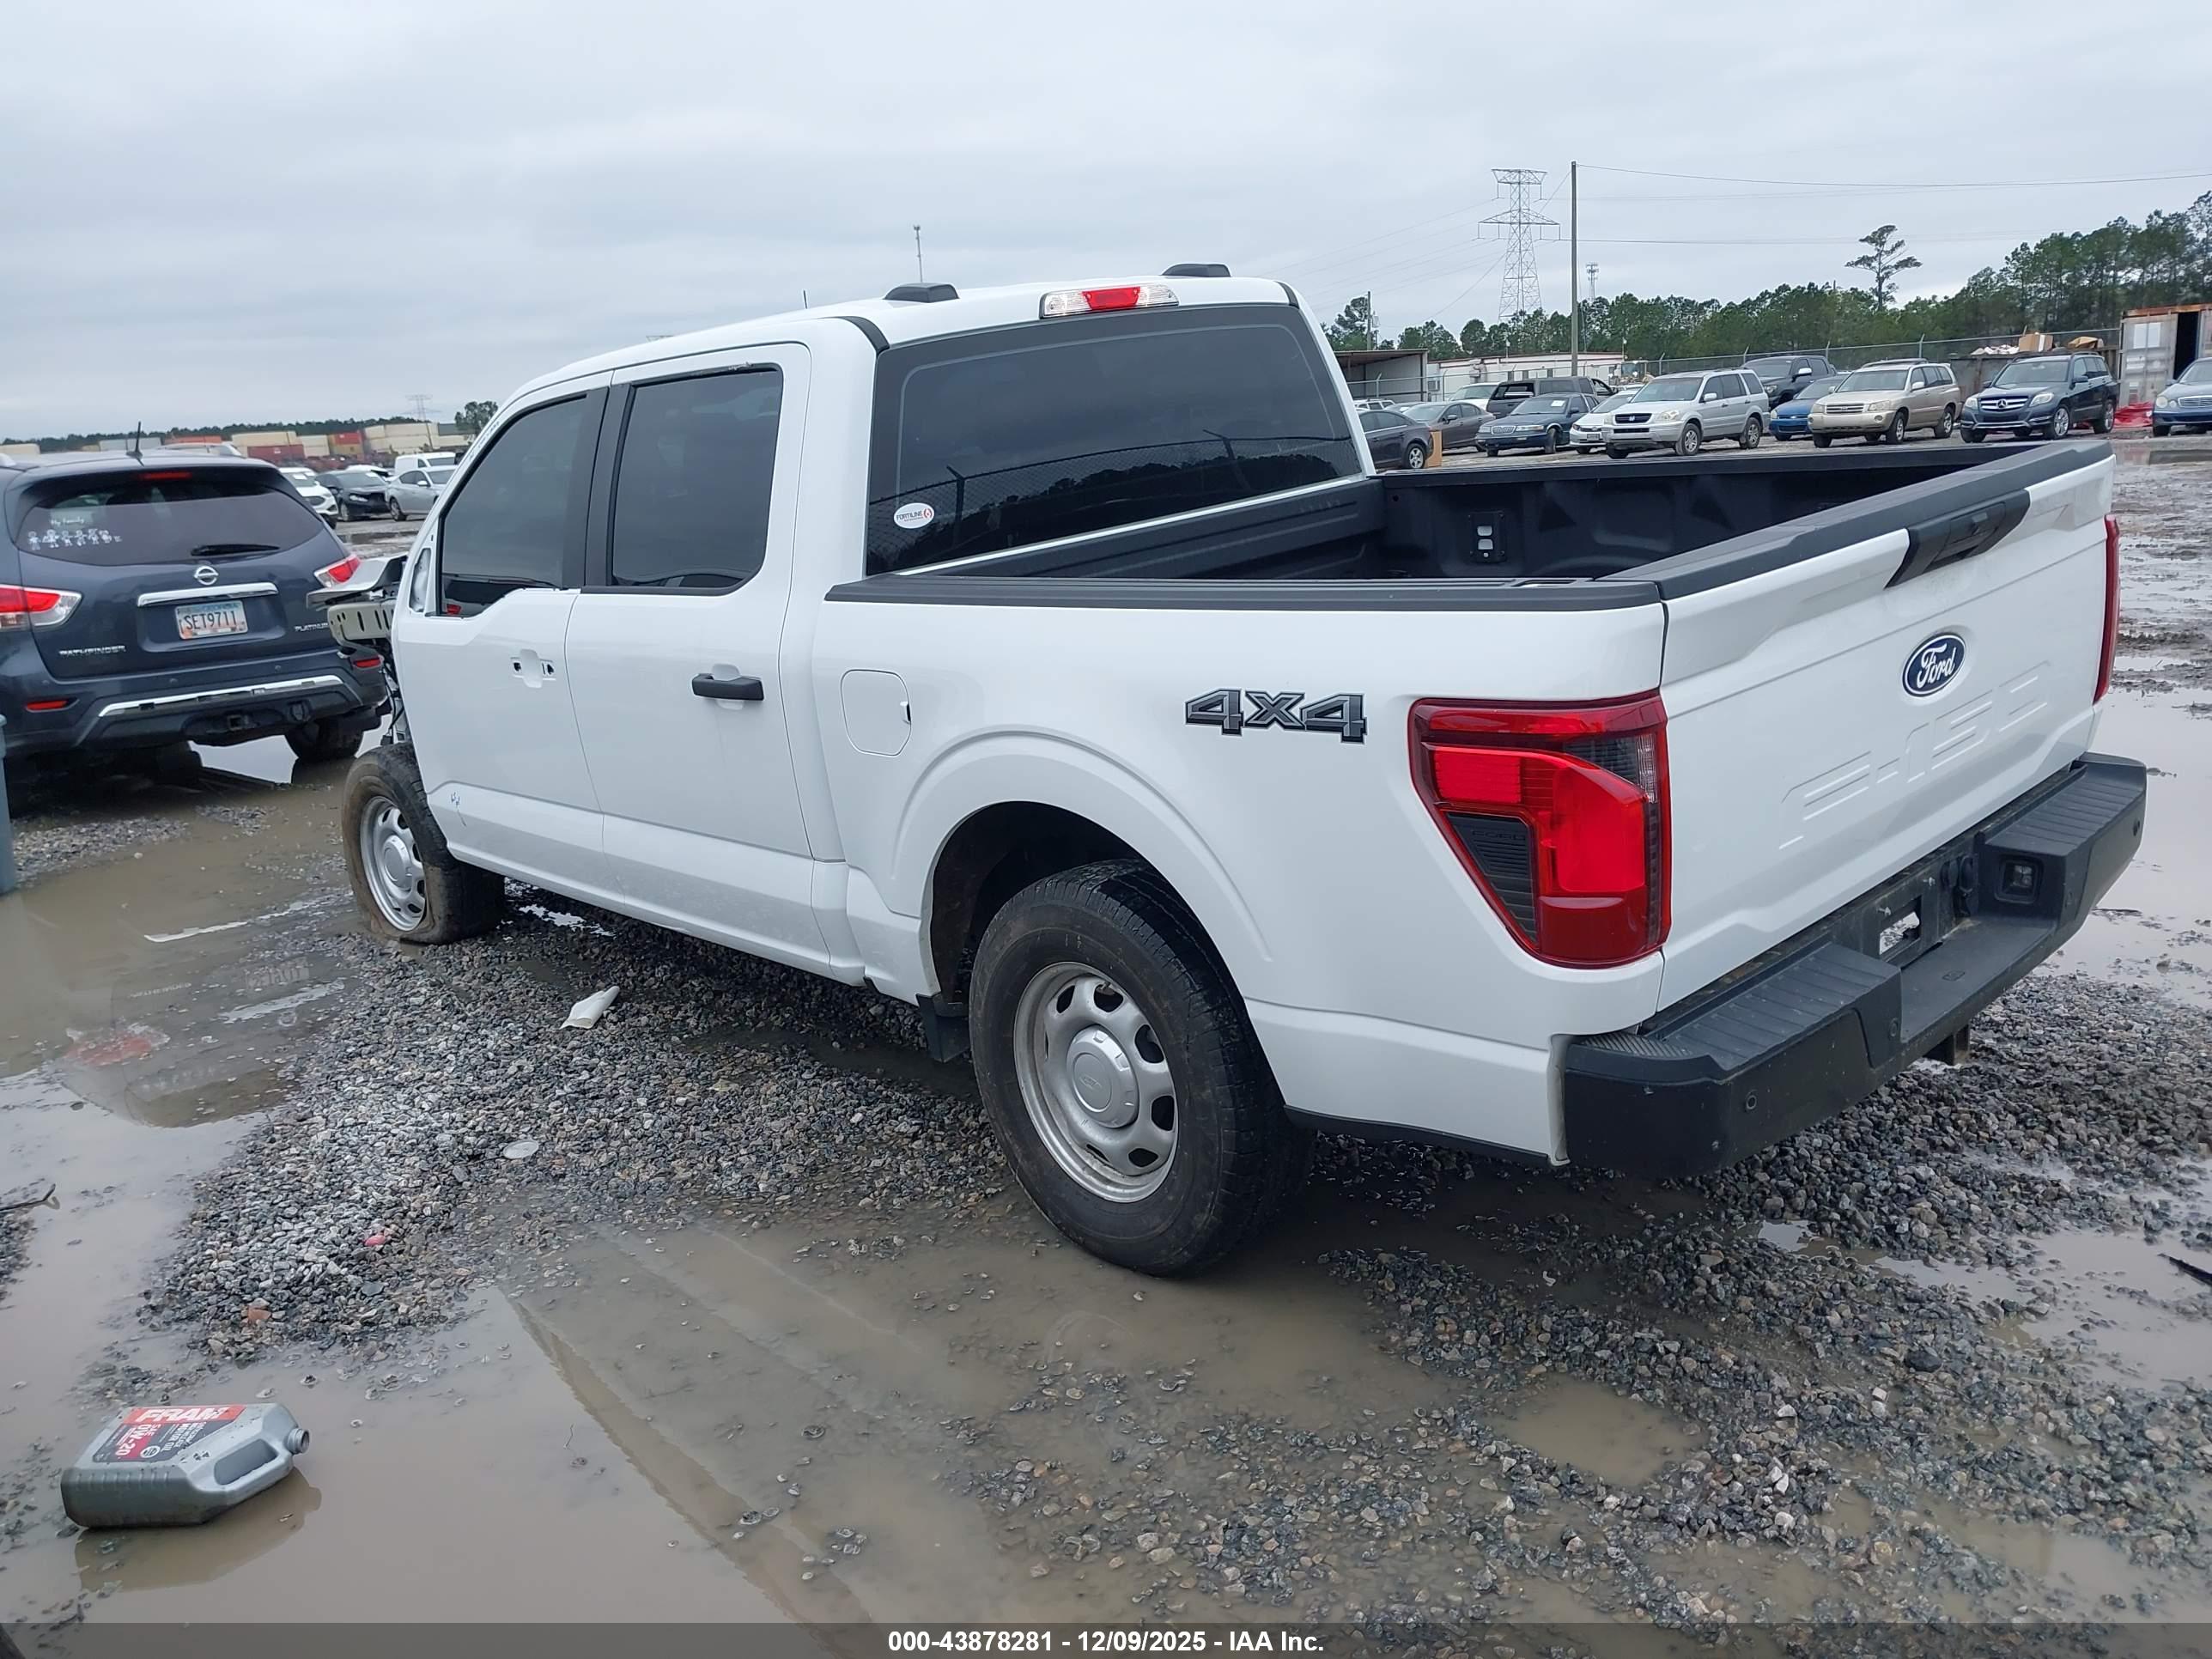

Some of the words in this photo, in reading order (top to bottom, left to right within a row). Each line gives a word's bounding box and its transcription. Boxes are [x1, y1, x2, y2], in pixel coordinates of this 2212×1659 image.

[183, 611, 237, 630] SET9711
[1917, 642, 1957, 689] Ford
[135, 1407, 231, 1423] FRAM
[114, 1425, 152, 1455] 0W-20
[143, 1424, 161, 1437] SAE
